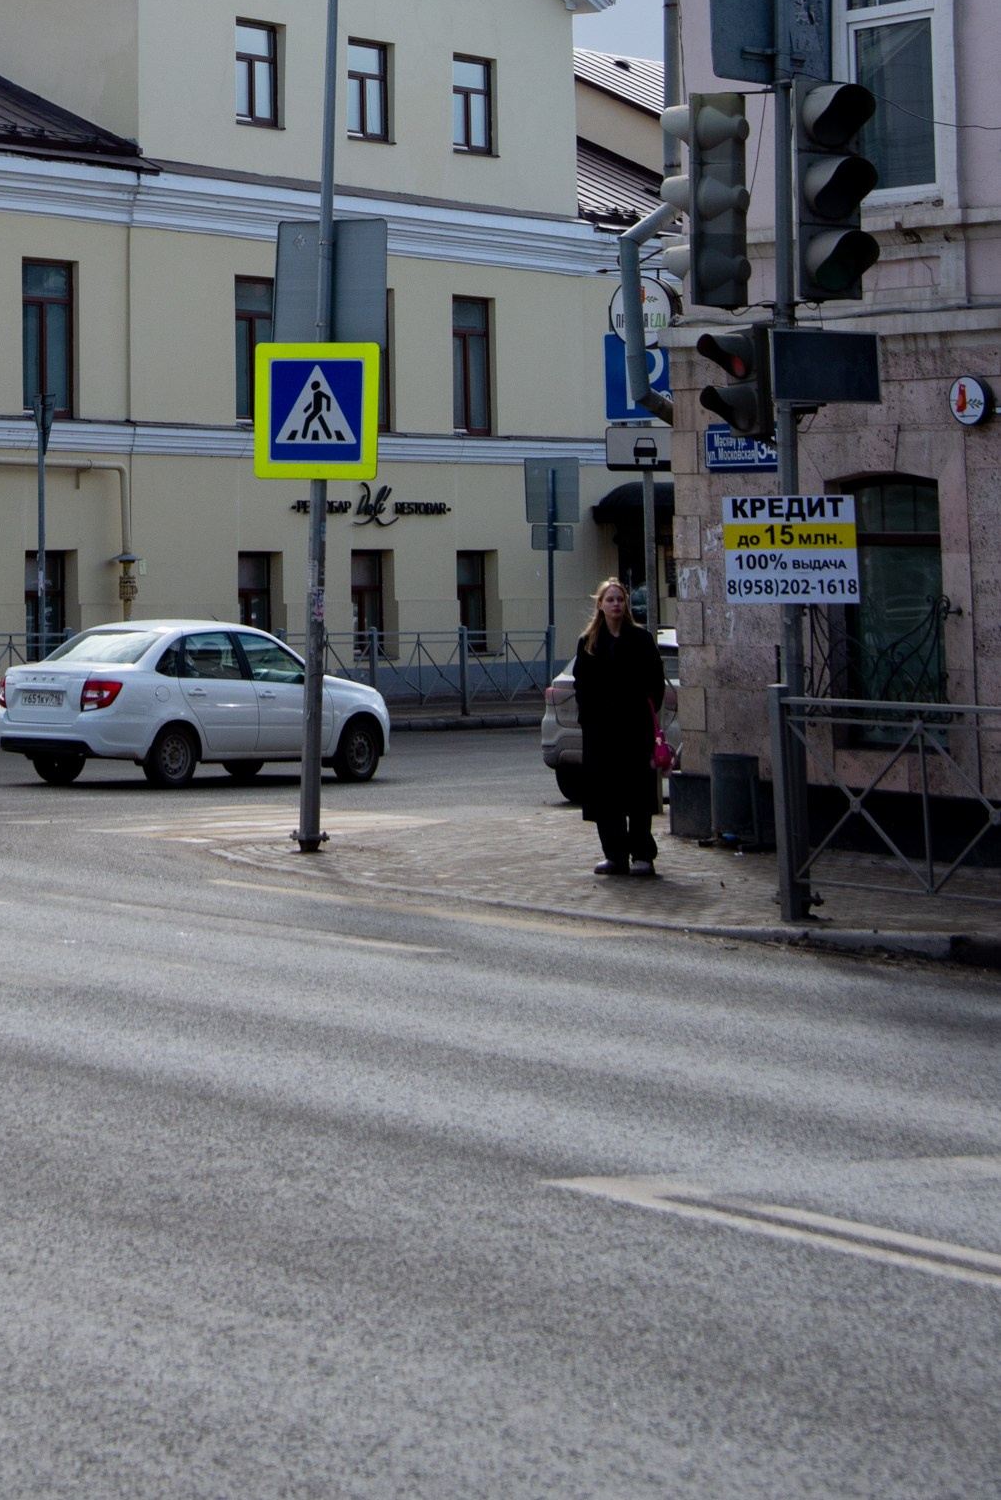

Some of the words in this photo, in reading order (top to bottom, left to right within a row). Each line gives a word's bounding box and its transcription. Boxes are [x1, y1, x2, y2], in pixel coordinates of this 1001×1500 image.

[718, 447, 755, 461] Московская
[297, 500, 352, 514] РЕОБАР
[731, 497, 844, 522] КРЕДИТ
[737, 534, 760, 548] до
[765, 524, 794, 546] 15
[798, 533, 844, 546] млн.
[735, 553, 788, 571] 100%
[792, 559, 848, 571] ВЫДАЧА
[727, 577, 858, 598] 8(958)202-1618
